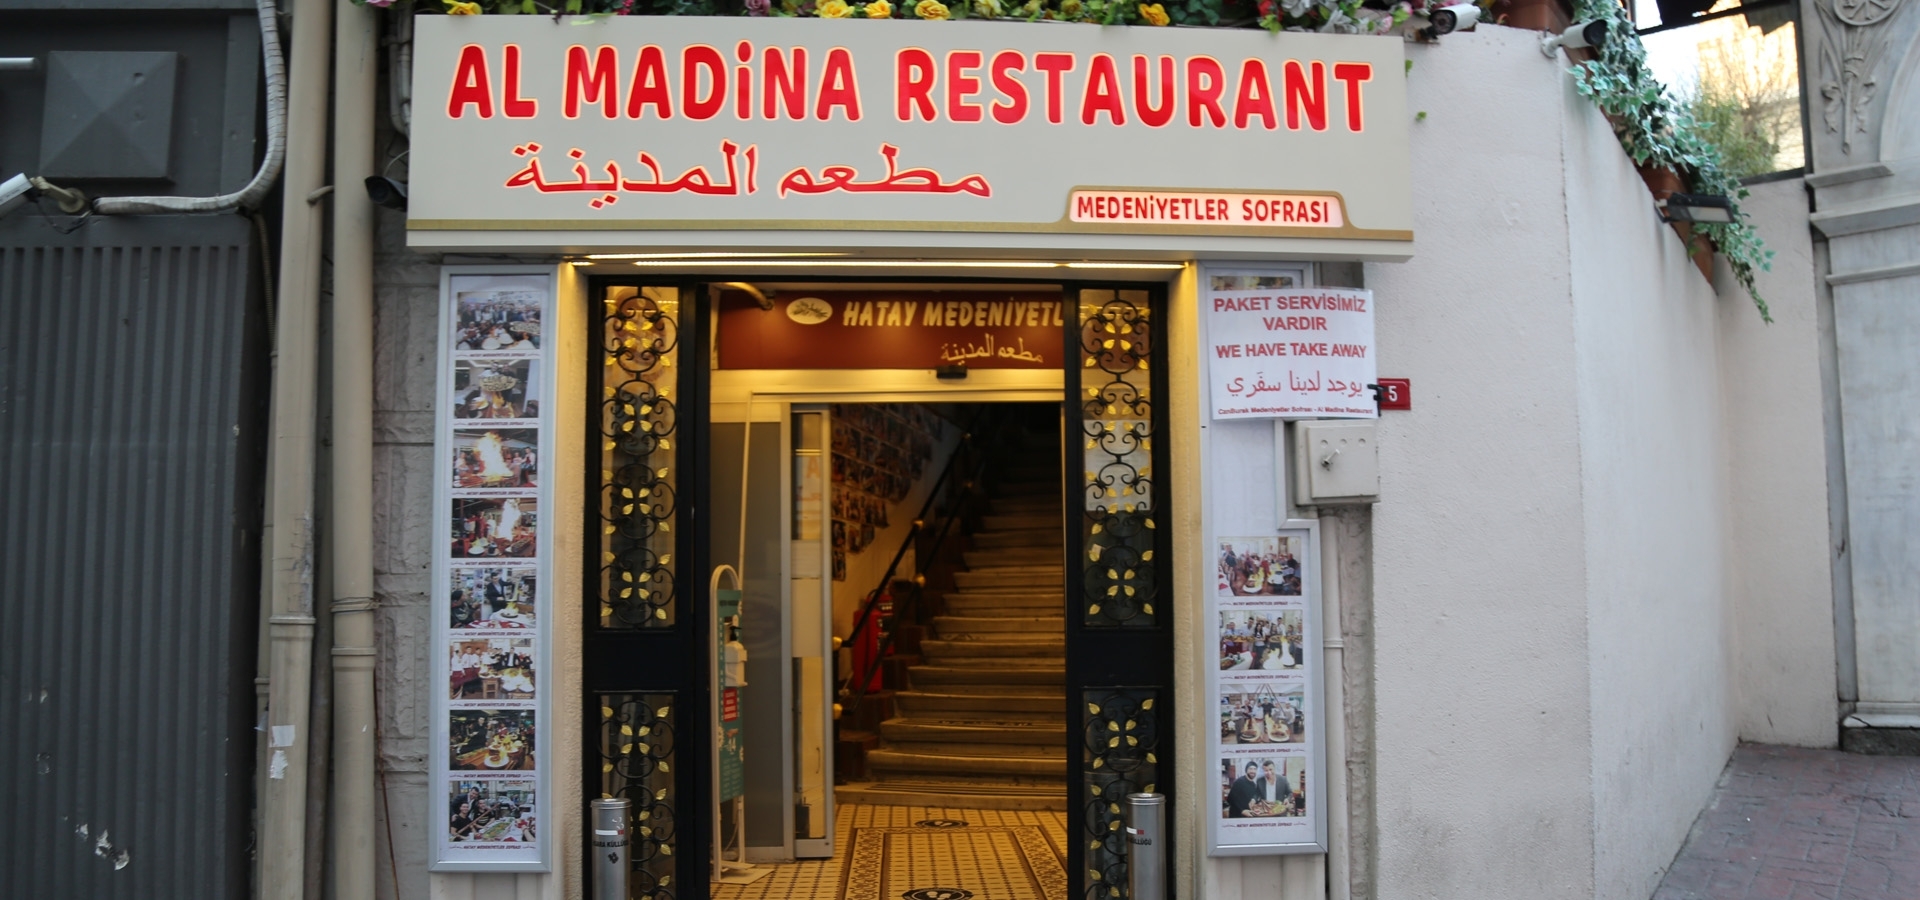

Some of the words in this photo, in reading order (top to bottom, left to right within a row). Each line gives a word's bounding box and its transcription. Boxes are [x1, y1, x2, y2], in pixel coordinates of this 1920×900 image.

[446, 43, 538, 120] AL
[894, 46, 1374, 132] RESTAURANT
[504, 138, 760, 210] المدينة
[777, 141, 992, 199] مطعم
[1242, 199, 1329, 223] SOFRASI
[842, 301, 918, 327] HATAY
[1213, 296, 1272, 312] PAKET
[1276, 292, 1367, 313] SERVİSİMİZ
[1262, 316, 1328, 331] VARDIR
[940, 333, 995, 366] المدينة
[997, 337, 1044, 363] مطعم
[1215, 344, 1242, 359] WE
[1245, 343, 1287, 357] HAVE
[1289, 342, 1329, 357] TAKE
[1330, 343, 1367, 359] AWAY
[1288, 370, 1322, 396] لدينا
[1326, 377, 1363, 398] يوجد
[1388, 385, 1398, 402] 5
